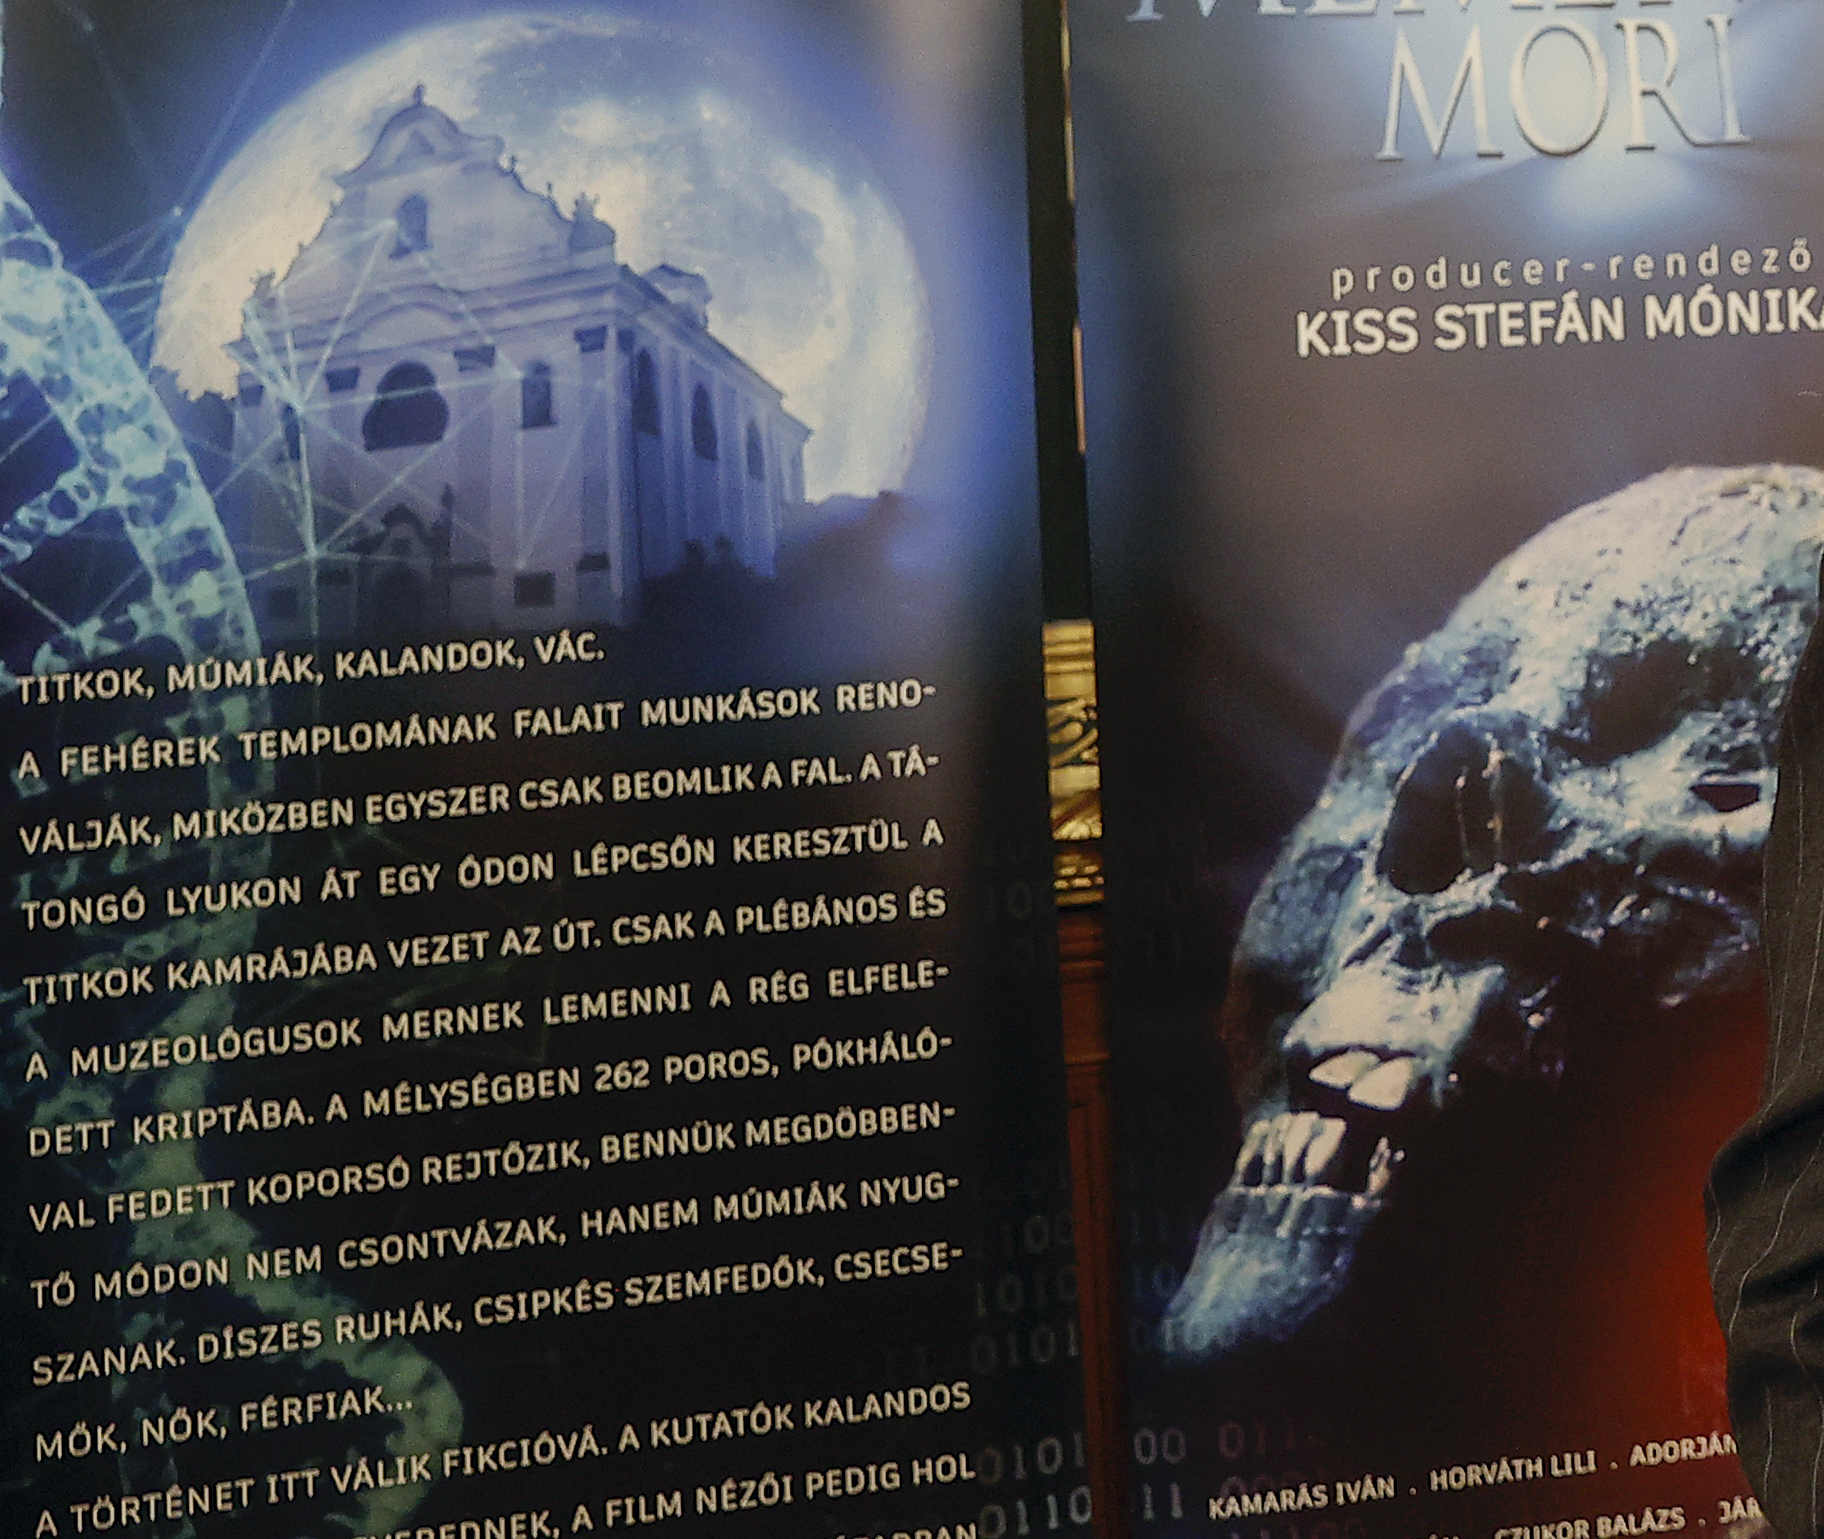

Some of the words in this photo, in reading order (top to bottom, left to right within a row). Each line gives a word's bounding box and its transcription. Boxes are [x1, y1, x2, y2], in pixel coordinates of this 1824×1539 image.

[1376, 13, 1752, 161] MORI
[1297, 307, 1418, 357] KISS
[1435, 289, 1624, 350] STEFÁN
[1331, 237, 1813, 301] producer-rendező
[14, 667, 154, 704] TITKOK,
[167, 651, 324, 692] MÚMIÁK,
[336, 639, 525, 679] KALANDOK,
[534, 629, 604, 664] VÁC.
[17, 751, 40, 780] A
[61, 735, 221, 776] FEHÉREK
[237, 712, 496, 760] TEMPLOMÁNAK
[514, 702, 624, 738] FALAIT
[641, 687, 820, 727] MUNKÁSOK
[837, 678, 936, 712] RENO-
[19, 813, 162, 855] VÁLJÁK,
[173, 798, 354, 841] MIKÖZBEN
[365, 784, 510, 824] EGYSZER
[519, 776, 603, 809] CSAK
[612, 763, 755, 801] BEOMLIK
[761, 761, 783, 789] A
[791, 757, 852, 787] FAL.
[860, 753, 882, 781] A
[887, 744, 939, 778] TÁ-
[21, 886, 145, 930] TONGÓ
[167, 877, 301, 916] LYUKON
[321, 867, 361, 901] ÁT
[379, 863, 441, 895] EGY
[458, 852, 554, 888] ÓDON
[733, 818, 909, 862] KERESZTÜL
[922, 818, 944, 846] A
[23, 965, 153, 1005] TITKOK
[167, 942, 377, 991] KAMRÁJÁBA
[387, 931, 490, 967] VEZET
[501, 926, 542, 956] AZ
[553, 917, 601, 951] ÚT.
[612, 911, 695, 945] CSAK
[704, 909, 725, 937] A
[736, 893, 898, 933] PLÉBÁNOS
[909, 885, 946, 918] ÉS
[26, 1052, 48, 1082] A
[72, 1018, 362, 1077] MUZEOLÓGUSOK
[383, 1001, 524, 1042] MERNEK
[544, 983, 691, 1024] LEMENNI
[709, 980, 731, 1008] A
[749, 970, 809, 1004] RÉG
[828, 959, 949, 997] ELFELE-
[29, 1119, 115, 1157] DETT
[133, 1098, 314, 1145] KRIPTÁBA.
[325, 1093, 348, 1122] A
[363, 1067, 580, 1117] MÉLYSÉGBEN
[595, 1059, 650, 1091] 262
[664, 1047, 779, 1084] POROS,
[793, 1026, 952, 1071] PÓKHÁLÓ-
[29, 1199, 96, 1232] VAL
[108, 1180, 235, 1223] FEDETT
[248, 1155, 410, 1206] KOPORSÓ
[601, 1120, 736, 1163] BENNÜK
[745, 1101, 955, 1147] MEGDÖBBEN-
[94, 1256, 228, 1301] MÓDON
[246, 1245, 322, 1281] NEM
[338, 1215, 566, 1269] CSONTVÁZAK,
[581, 1198, 699, 1238] HANEM
[714, 1180, 847, 1222] MÚMIÁK
[860, 1172, 959, 1207] NYUG-
[33, 1338, 186, 1385] SZANAK.
[198, 1318, 322, 1363] DÍSZES
[335, 1305, 464, 1346] RUHÁK,
[474, 1278, 614, 1325] CSIPKÉS
[834, 1242, 963, 1281] CSECSE-
[35, 1510, 58, 1539] A
[70, 1478, 255, 1533] TÖRTÉNET
[267, 1468, 320, 1503] ITT
[330, 1452, 431, 1493] VÁLIK
[443, 1425, 608, 1477] FIKCIÓVÁ.
[618, 1424, 640, 1452] A
[651, 1401, 794, 1448] KUTATÓK
[804, 1381, 971, 1427] KALANDOS
[241, 1385, 413, 1432] FÉRFIAK...
[572, 1504, 593, 1533] A
[606, 1490, 682, 1527] FILM
[806, 1462, 900, 1499] PEDIG
[912, 1453, 976, 1485] HOL
[1209, 1483, 1329, 1520] KAMARÁS
[1335, 1474, 1395, 1505] IVÁN
[1430, 1456, 1544, 1491] HORVÁTH
[1550, 1450, 1597, 1477] LILI
[1597, 1507, 1686, 1539] BALÁZS
